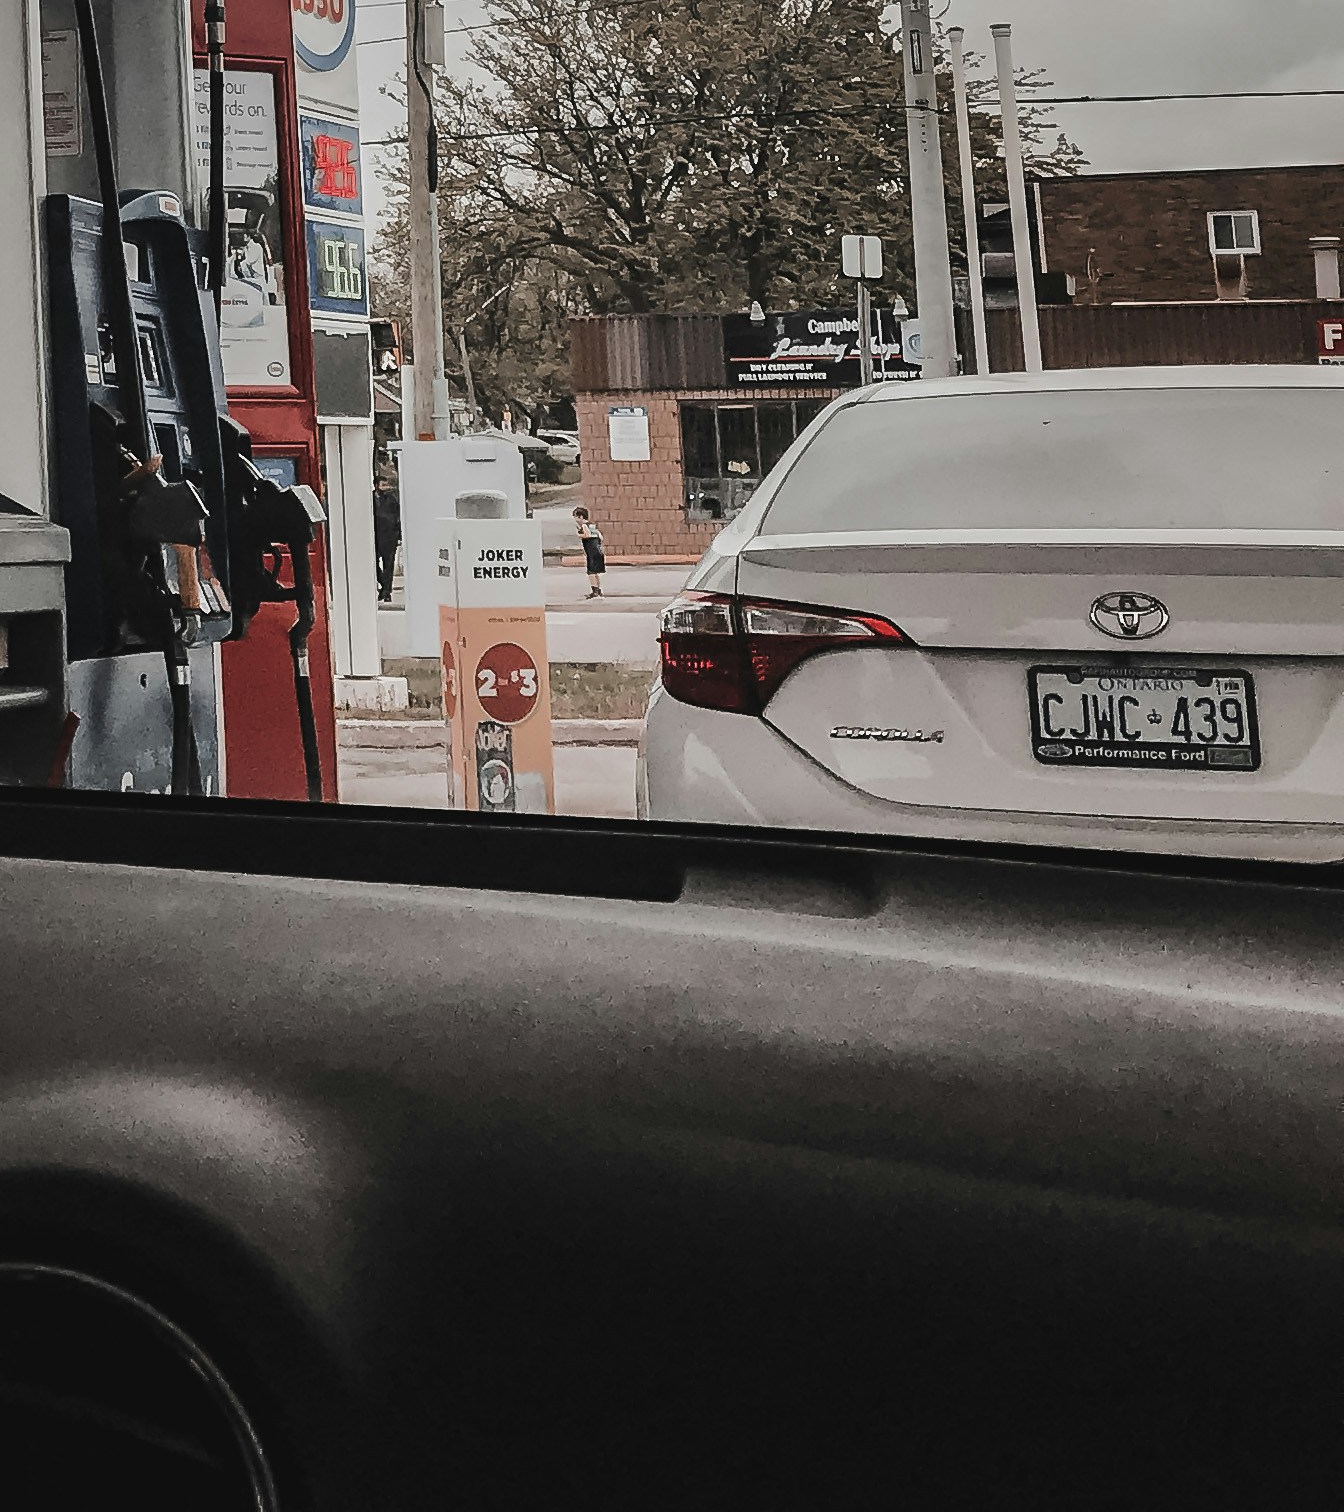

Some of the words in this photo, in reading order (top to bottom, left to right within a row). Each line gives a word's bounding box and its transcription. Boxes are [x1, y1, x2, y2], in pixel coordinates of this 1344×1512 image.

[770, 338, 848, 363] Laundry
[477, 550, 523, 562] JOKER
[473, 566, 529, 579] ENERGY
[478, 669, 497, 697] 2
[1098, 677, 1184, 692] ONTARIO
[1042, 693, 1141, 740] CJWC
[1171, 696, 1244, 743] 439
[1075, 746, 1168, 760] Performance
[1172, 749, 1205, 761] Ford
